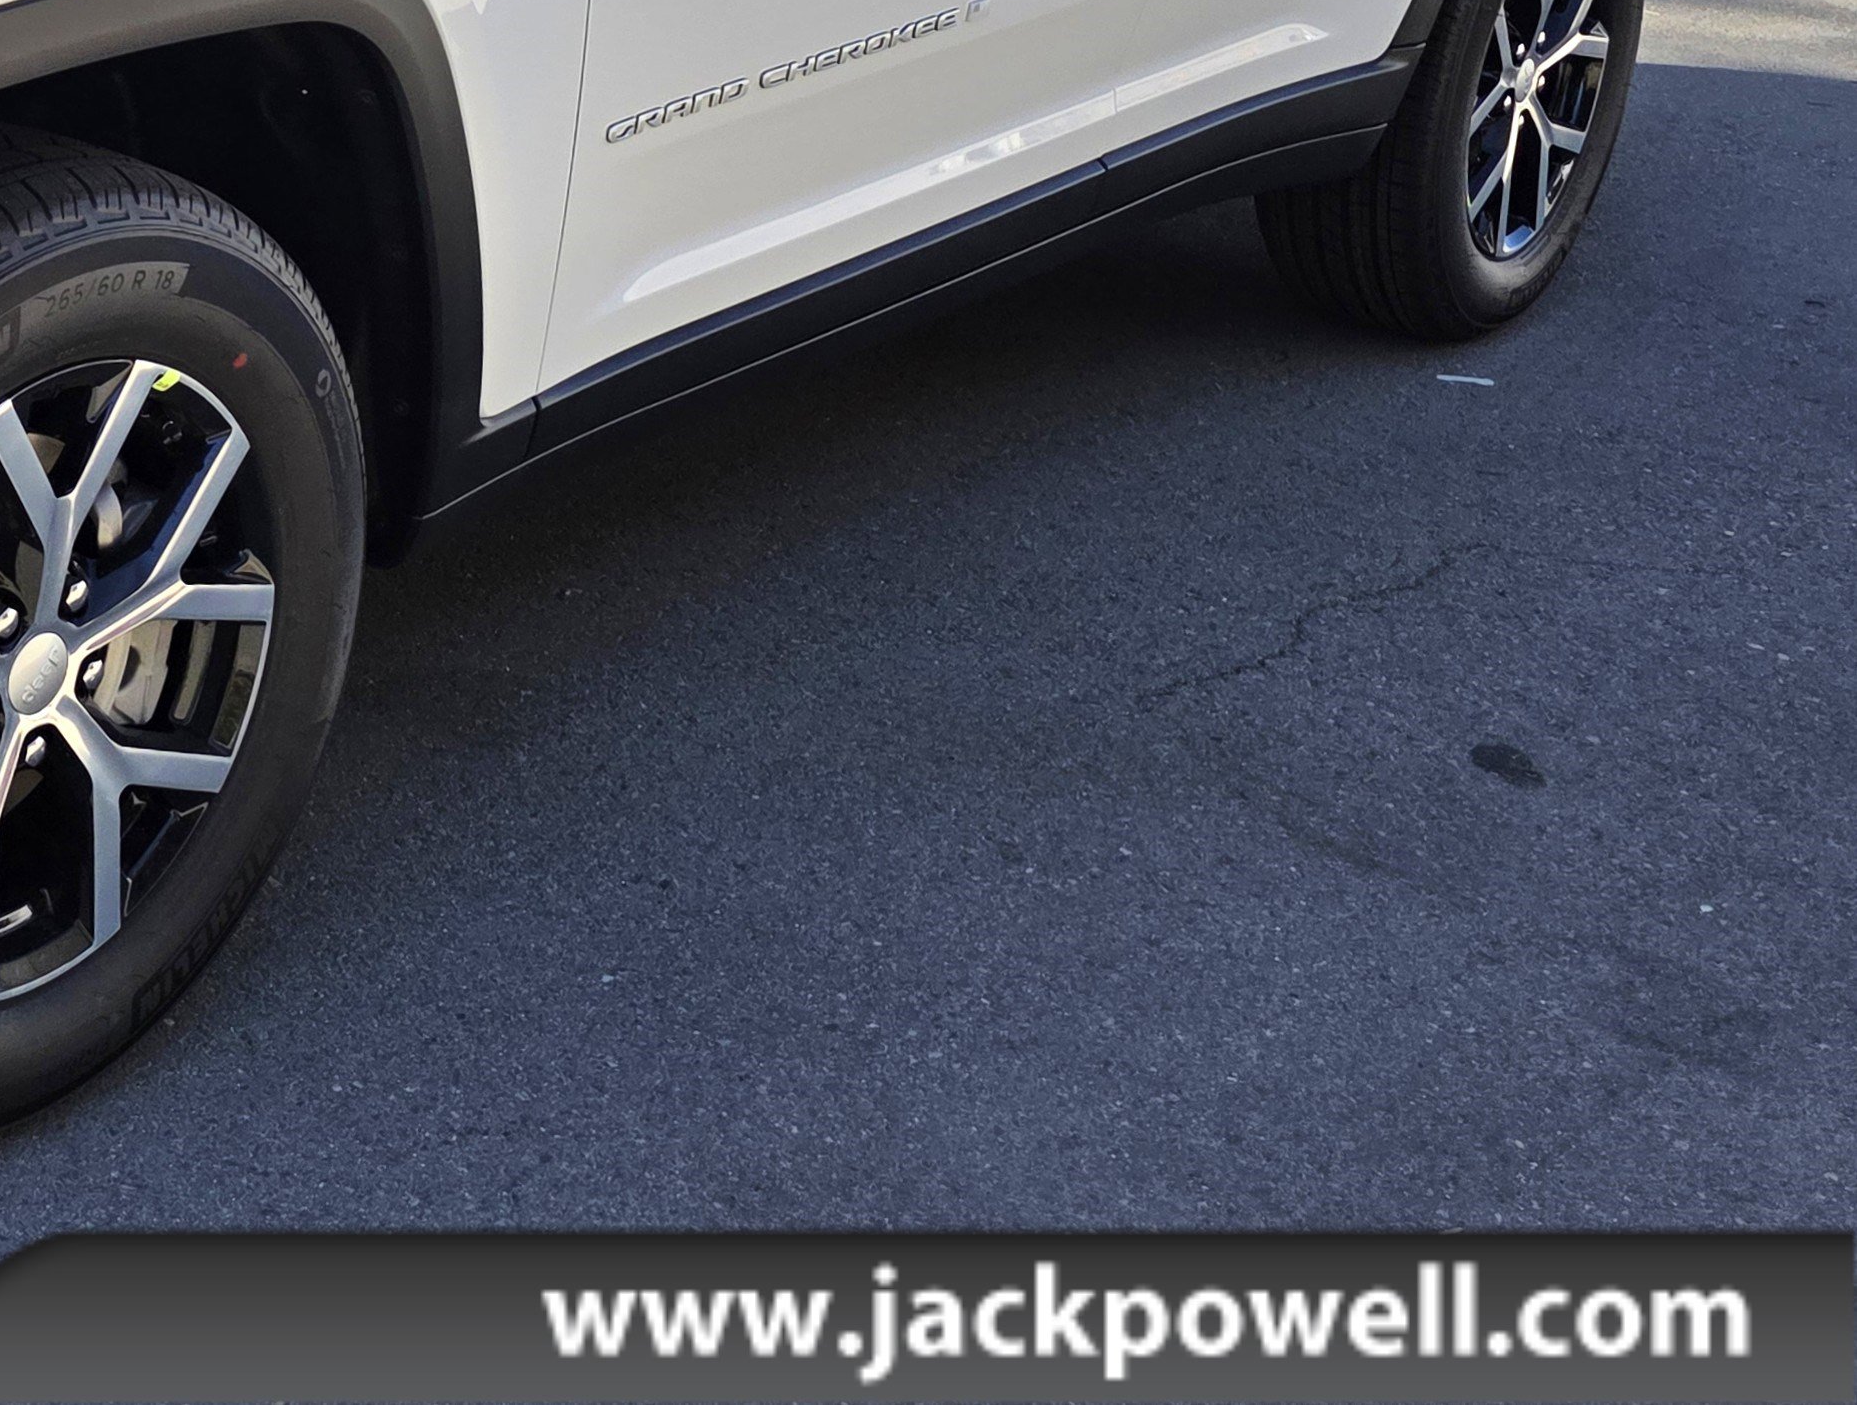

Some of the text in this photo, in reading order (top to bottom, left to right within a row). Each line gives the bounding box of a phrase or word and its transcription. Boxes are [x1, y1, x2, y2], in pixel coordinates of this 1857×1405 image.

[606, 8, 960, 144] GRAND CHEROKEE
[44, 270, 175, 317] 265/60 R 18
